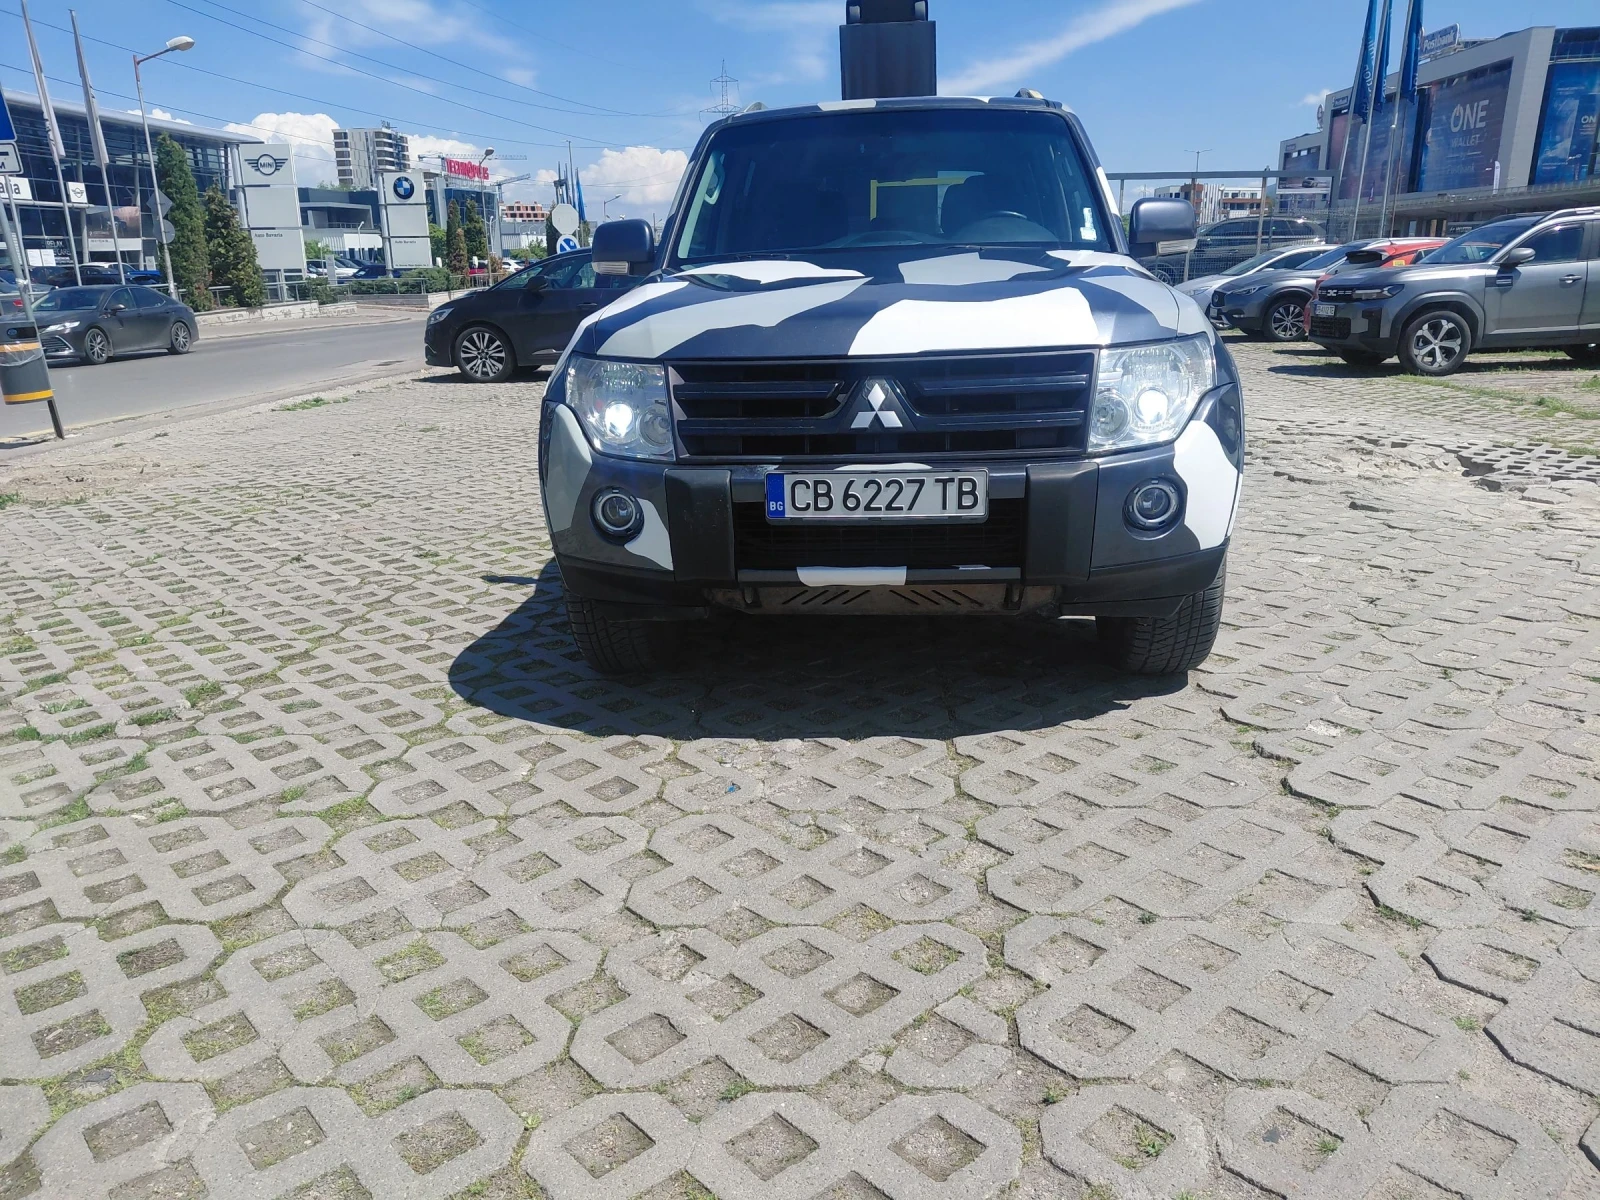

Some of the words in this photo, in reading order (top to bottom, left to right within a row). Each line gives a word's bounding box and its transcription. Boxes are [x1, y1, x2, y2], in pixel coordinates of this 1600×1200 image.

[1423, 30, 1455, 52] Postbank
[1451, 99, 1489, 132] ONE
[1451, 134, 1480, 148] WALLET
[259, 161, 274, 169] MINI
[0, 178, 21, 195] aia
[790, 478, 834, 512] CB
[842, 478, 926, 512] 6227
[934, 477, 979, 511] TB
[769, 501, 784, 511] BG
